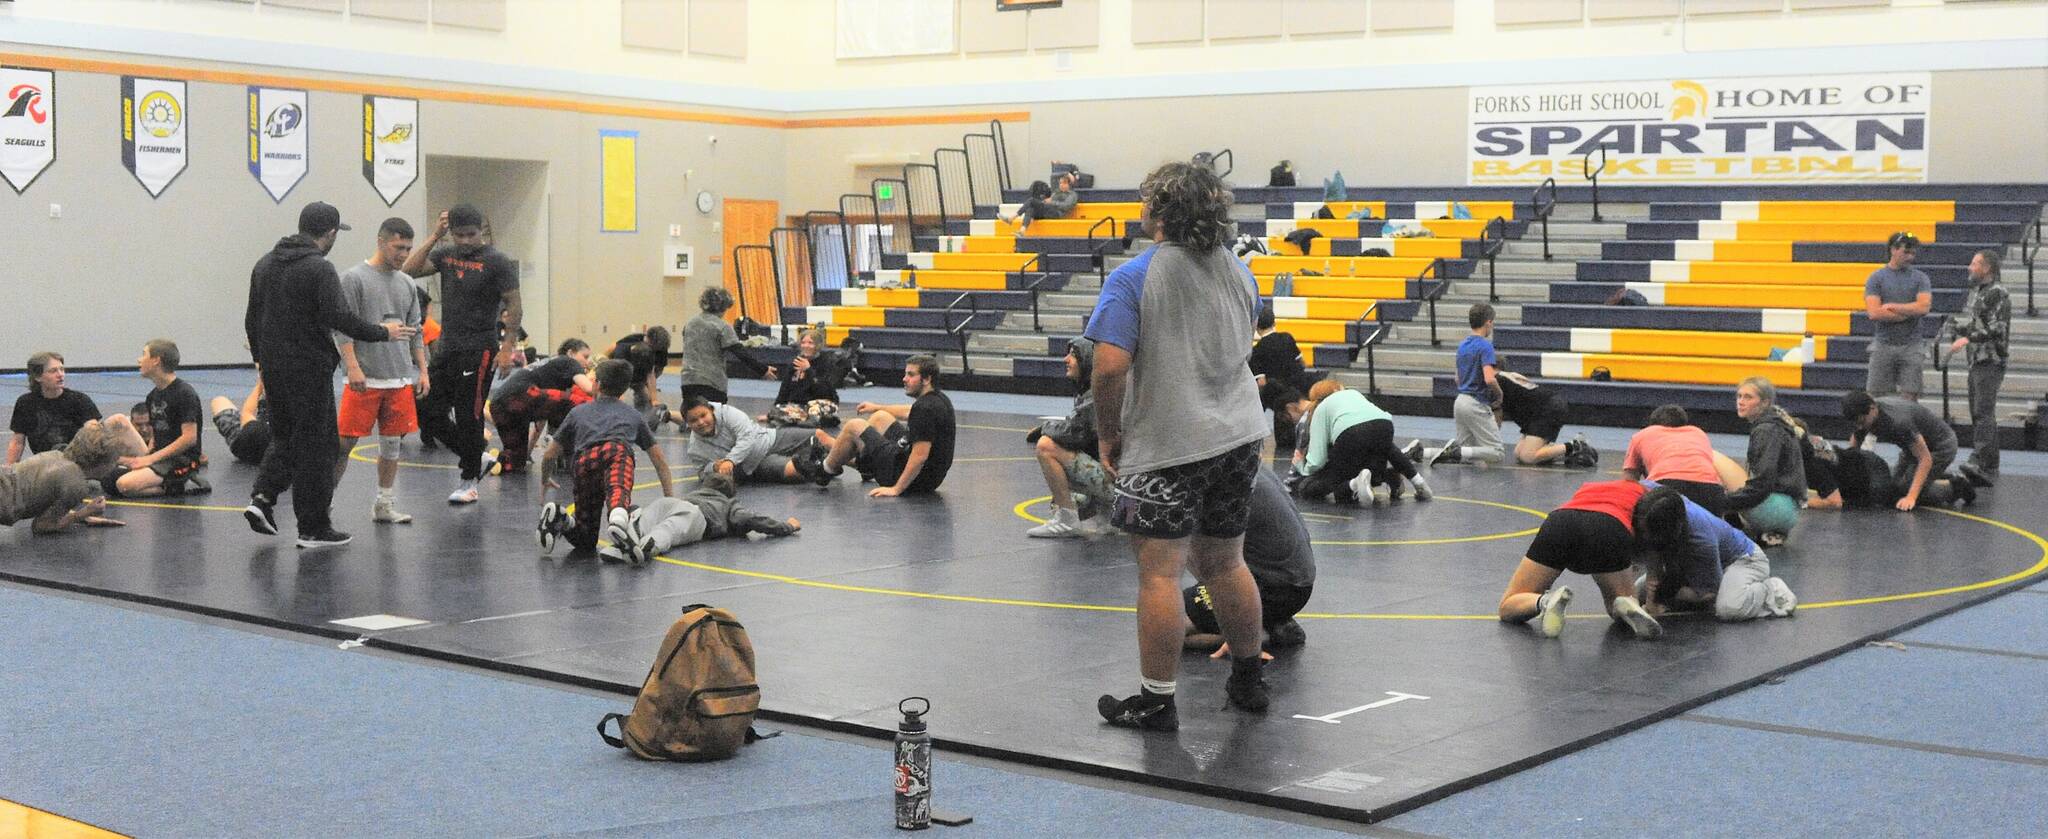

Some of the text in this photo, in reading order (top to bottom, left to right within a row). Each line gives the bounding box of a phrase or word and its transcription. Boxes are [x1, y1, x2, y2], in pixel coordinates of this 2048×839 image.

[1475, 92, 1664, 113] FORKS HIGH SCHOOL
[1715, 84, 1924, 107] HOME OF
[4, 138, 46, 147] SEAGULLS
[1474, 118, 1925, 157] SPARTAN
[139, 145, 182, 154] FISHERMEN
[264, 152, 302, 160] WARRIORS
